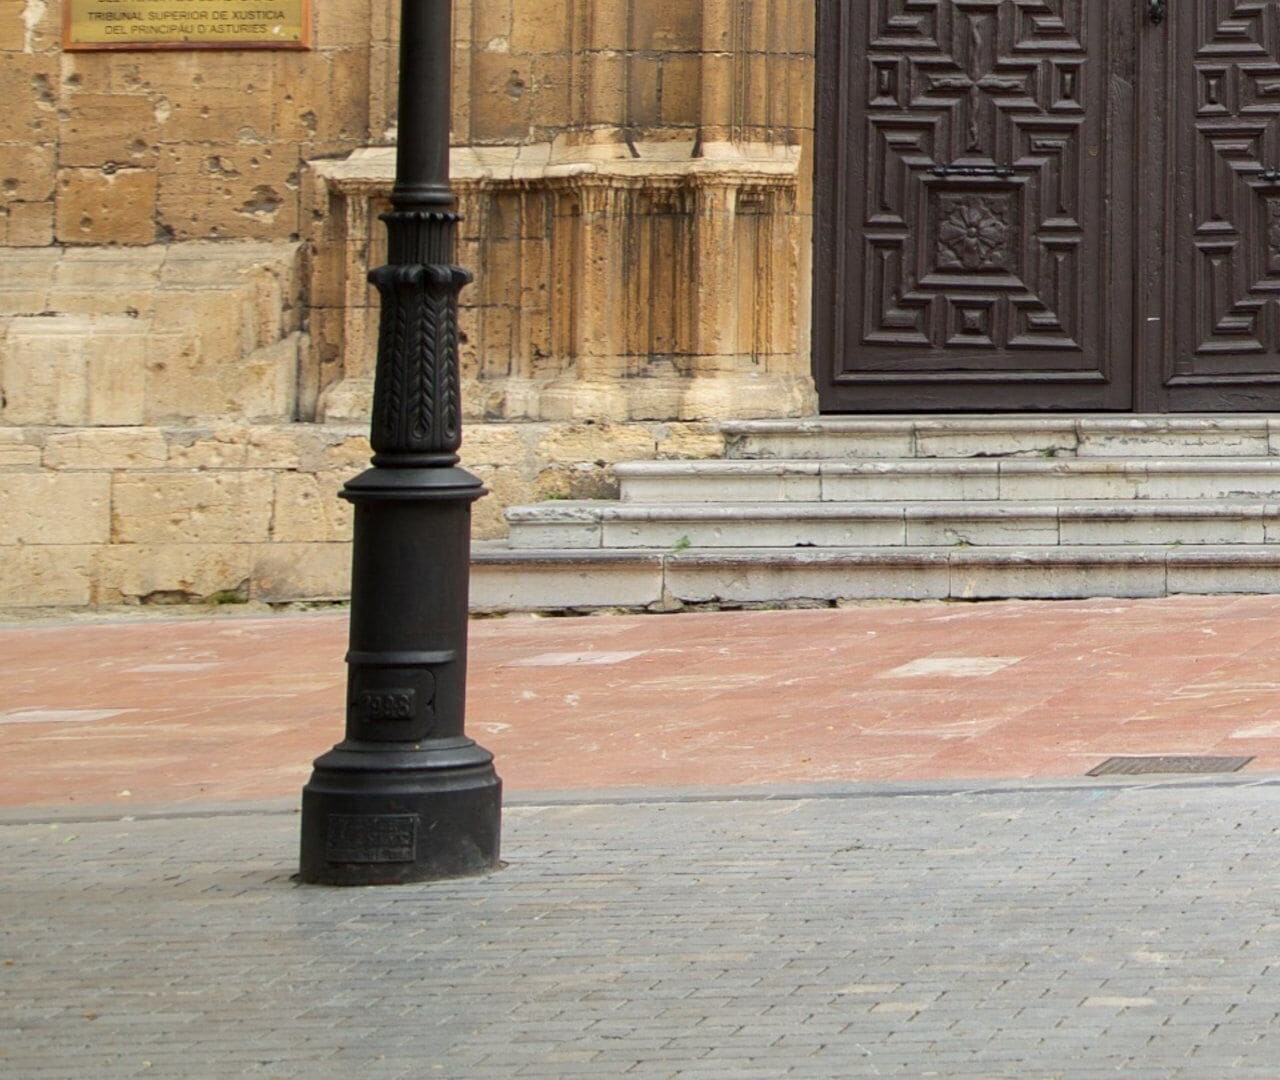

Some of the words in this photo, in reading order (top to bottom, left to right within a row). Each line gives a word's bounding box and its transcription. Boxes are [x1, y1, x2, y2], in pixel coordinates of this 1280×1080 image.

[88, 11, 144, 21] TRIBUNAL
[148, 10, 209, 20] SUPERIOR
[211, 10, 230, 20] DE
[232, 10, 286, 19] XUSTICIA
[104, 25, 128, 34] DEL
